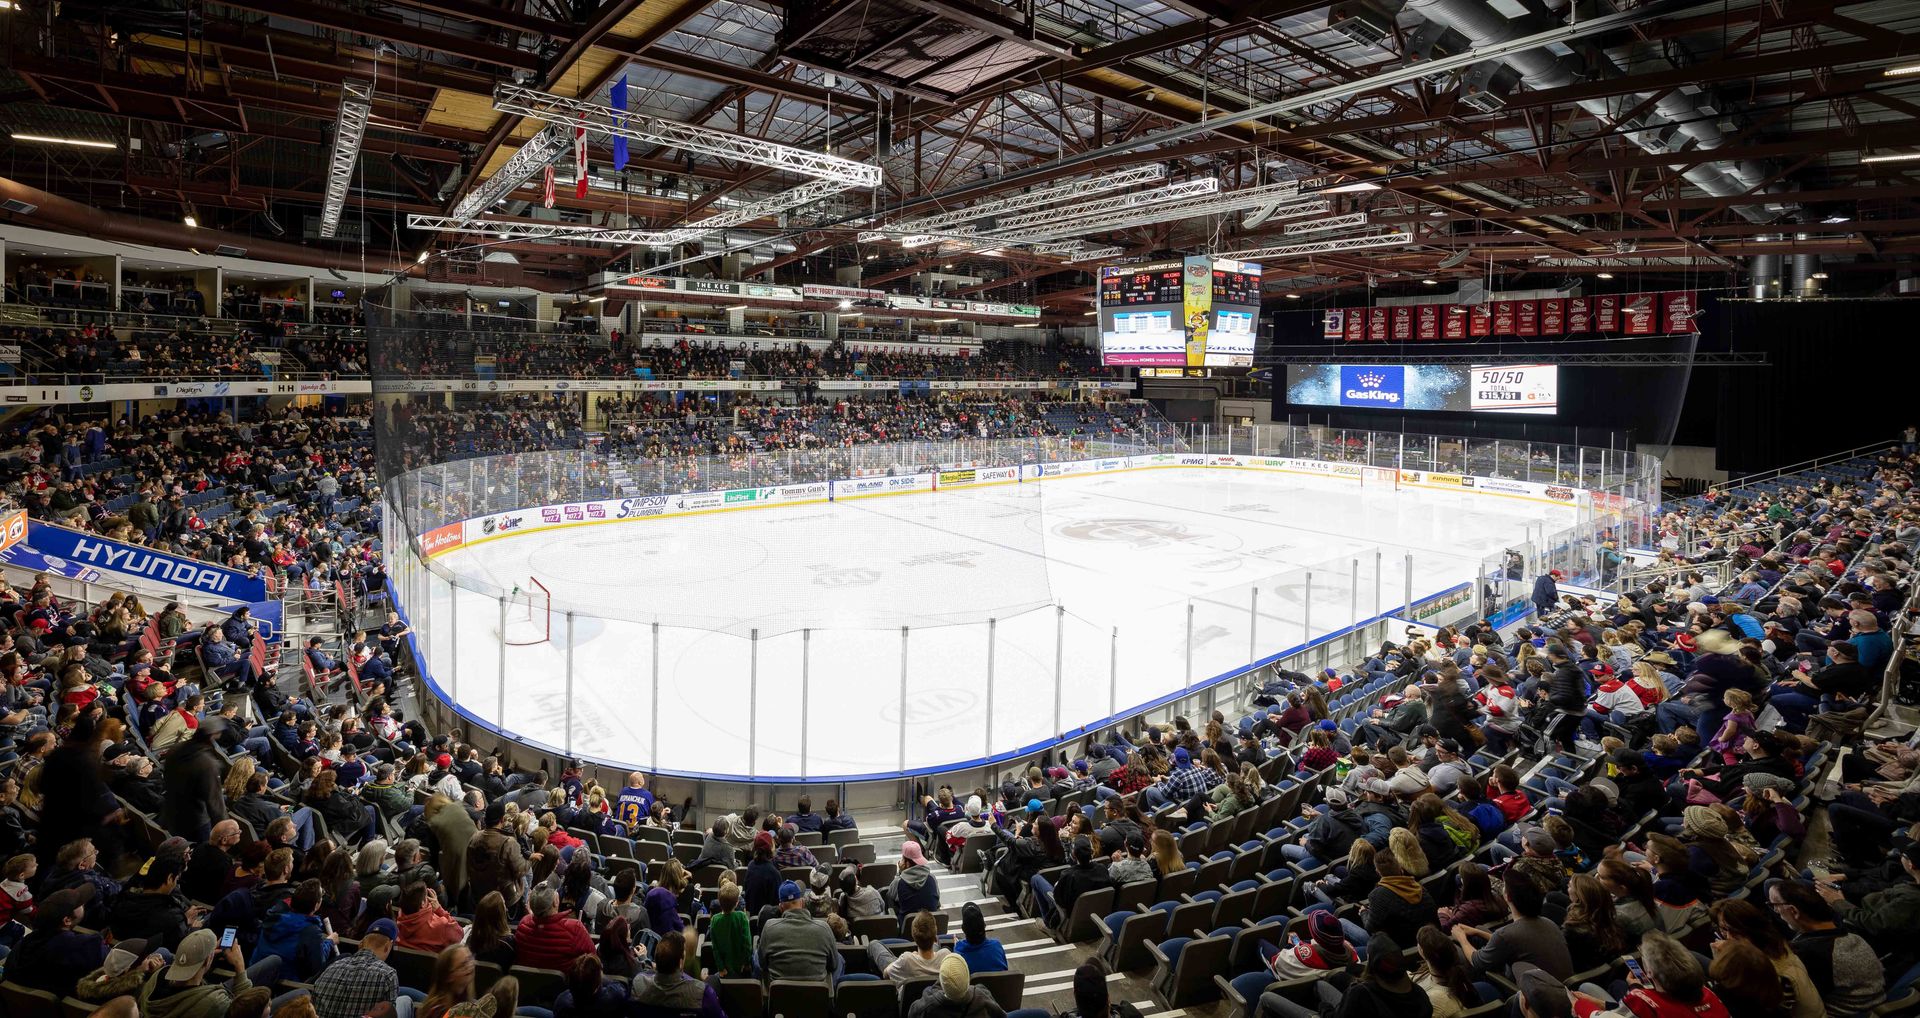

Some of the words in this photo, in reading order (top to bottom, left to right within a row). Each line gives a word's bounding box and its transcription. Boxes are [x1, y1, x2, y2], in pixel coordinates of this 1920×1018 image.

[1135, 275, 1151, 284] 2:59
[740, 342, 759, 350] OF
[853, 345, 941, 356] HURRICANES
[1481, 372, 1524, 383] 50/50
[1481, 391, 1516, 400] $15,751
[1248, 459, 1285, 467] SUBWAY
[983, 471, 1008, 480] SAFEWAY
[780, 487, 805, 496] Tommy
[808, 485, 826, 493] Gun's
[617, 496, 669, 518] SIMPSON
[628, 508, 664, 518] PLUMBING
[434, 531, 461, 547] Hortons
[72, 538, 230, 592] HYUNDAI
[619, 802, 639, 828] 13
